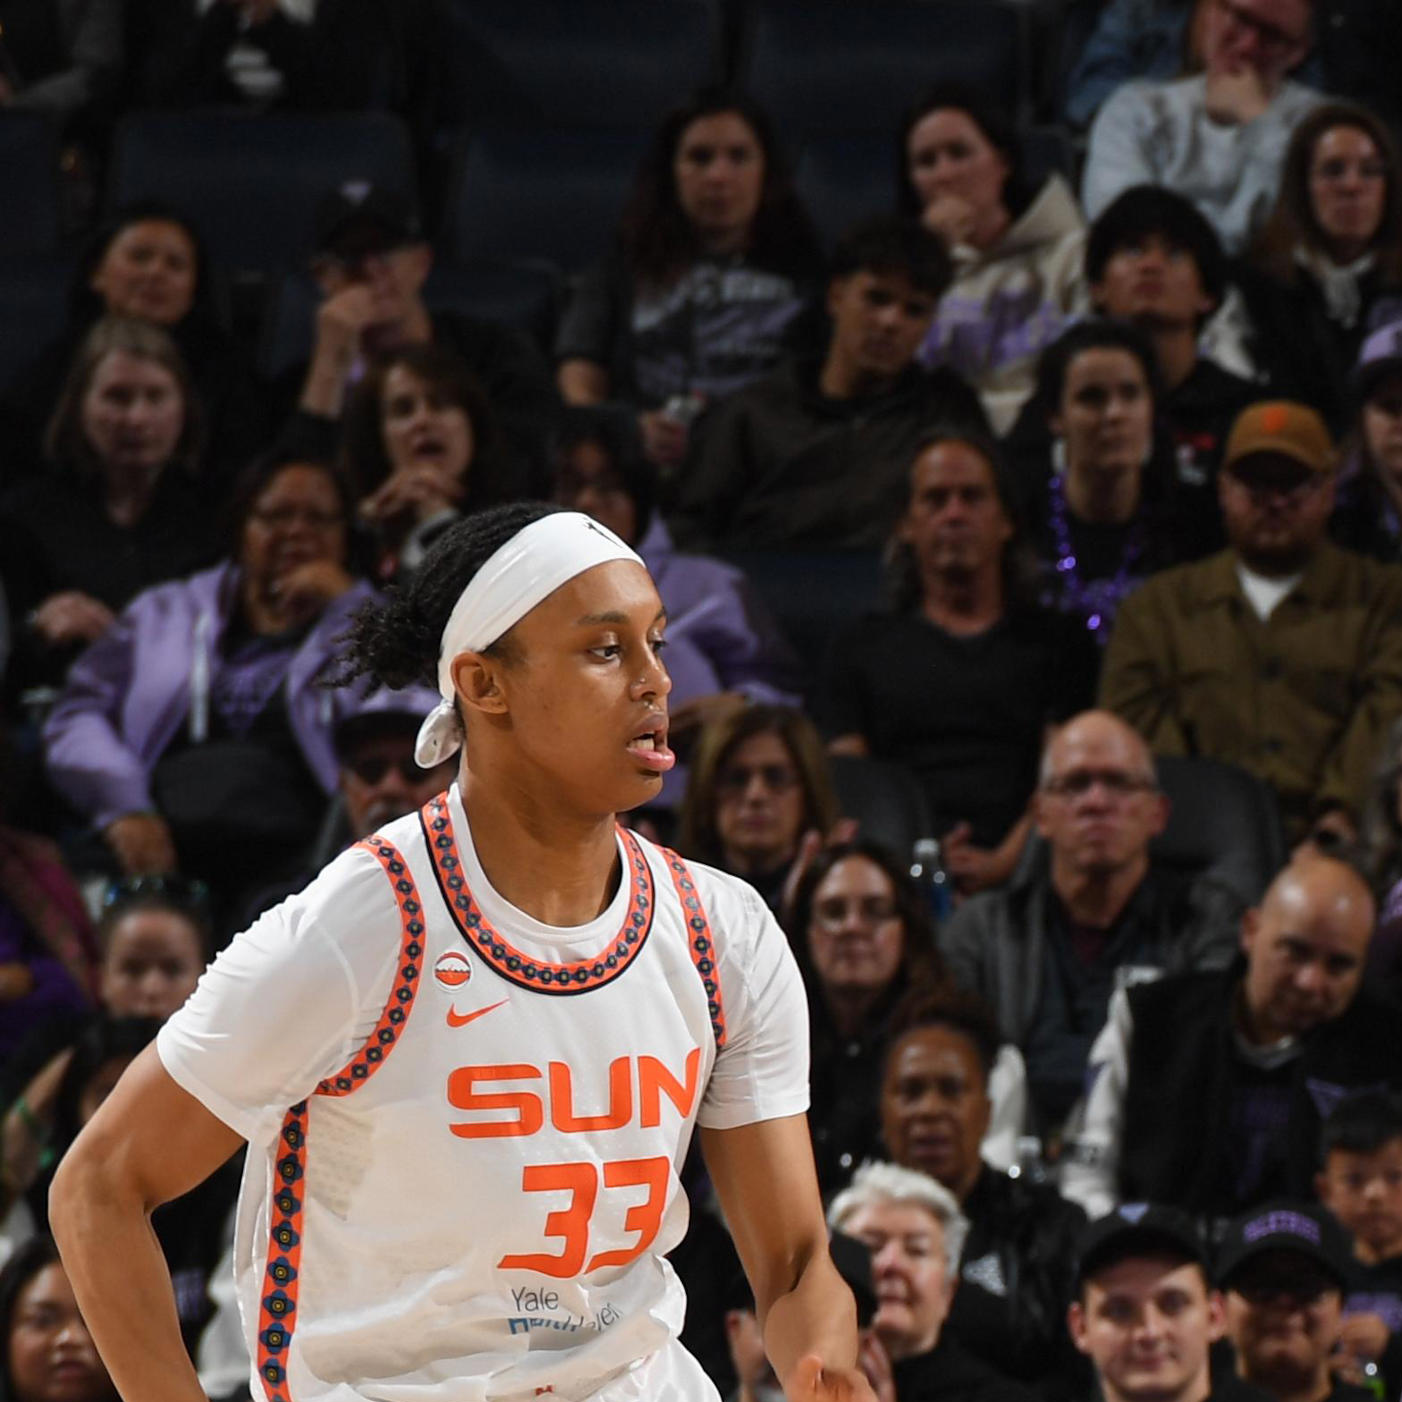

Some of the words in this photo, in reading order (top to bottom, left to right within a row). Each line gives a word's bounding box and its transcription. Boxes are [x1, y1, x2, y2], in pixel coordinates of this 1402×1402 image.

[447, 1048, 701, 1139] SUN
[497, 1156, 671, 1280] 33
[511, 1286, 559, 1313] Yale
